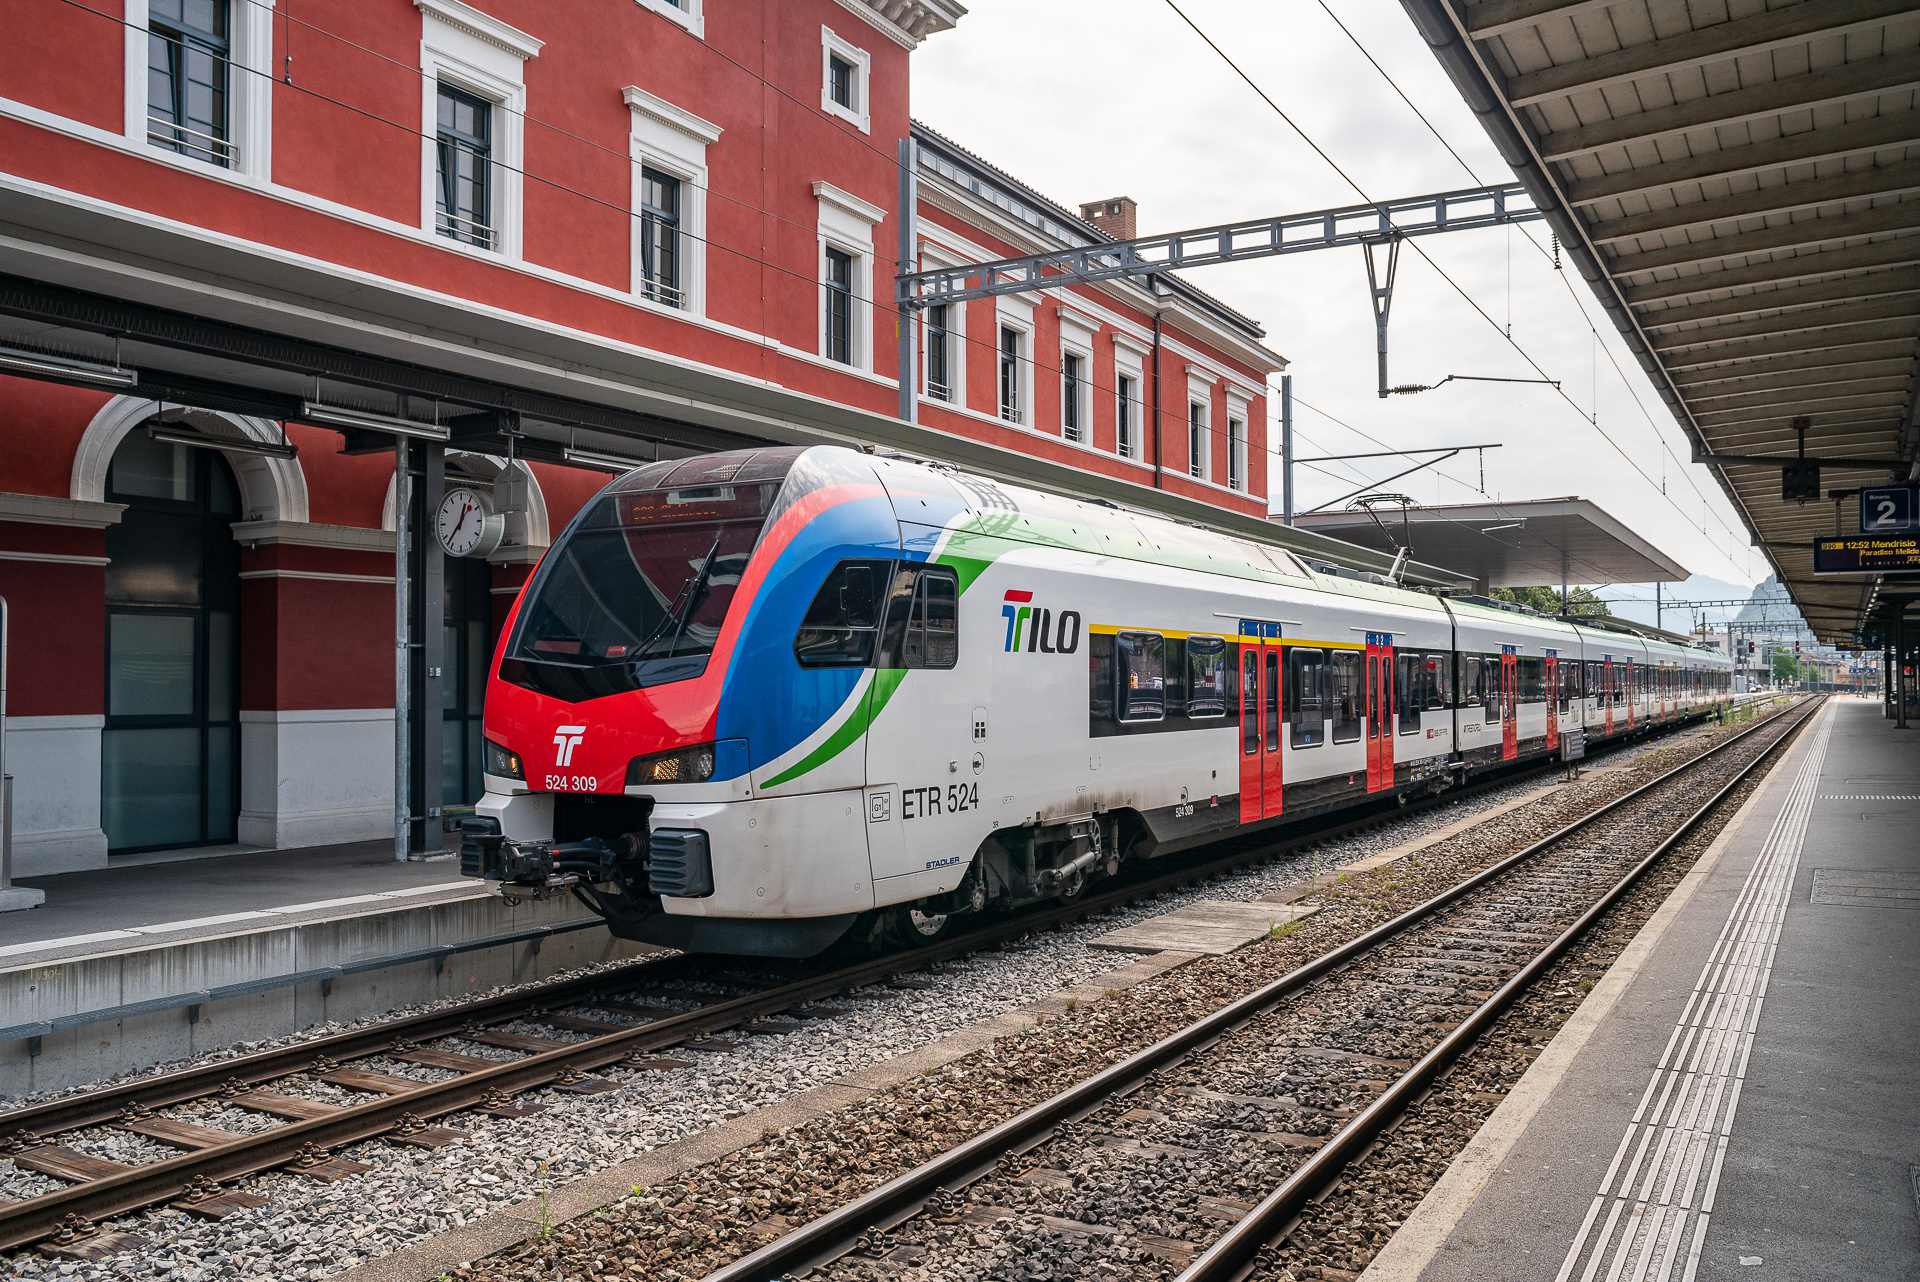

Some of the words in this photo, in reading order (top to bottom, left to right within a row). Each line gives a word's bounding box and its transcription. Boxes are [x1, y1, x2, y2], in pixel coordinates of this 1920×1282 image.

[1877, 501, 1896, 524] 2
[1846, 541, 1870, 549] 12:52
[1871, 540, 1917, 548] Mendrisio
[1001, 589, 1081, 654] TILO
[545, 774, 568, 790] 524
[571, 775, 597, 791] 309
[874, 803, 882, 812] G1
[902, 786, 941, 820] ETR
[947, 781, 979, 813] 524
[1175, 806, 1185, 818] 524
[1185, 804, 1194, 816] 309
[925, 856, 960, 869] STADLER
